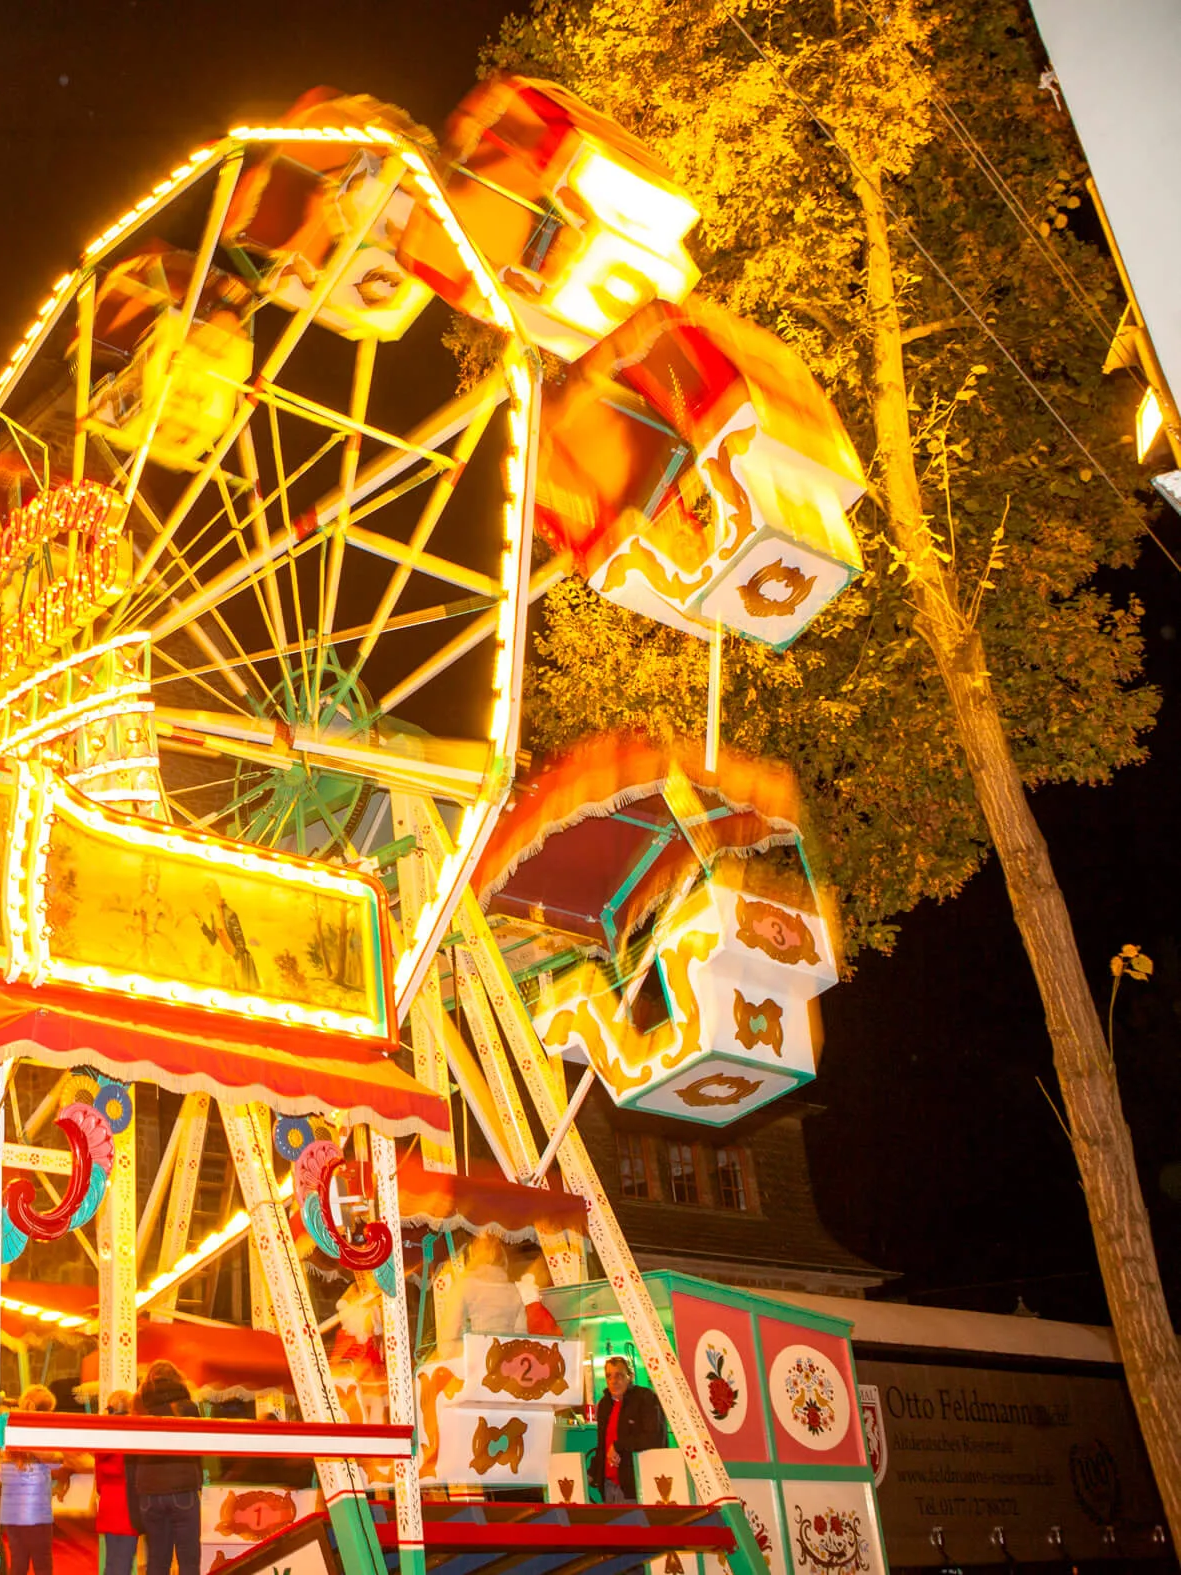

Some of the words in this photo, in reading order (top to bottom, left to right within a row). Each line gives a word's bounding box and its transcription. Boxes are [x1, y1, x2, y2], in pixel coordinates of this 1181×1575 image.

[771, 921, 786, 946] 3
[520, 1357, 533, 1382] 2
[886, 1385, 935, 1420] Otto
[939, 1387, 1033, 1425] Feldmann
[254, 1506, 262, 1527] 1
